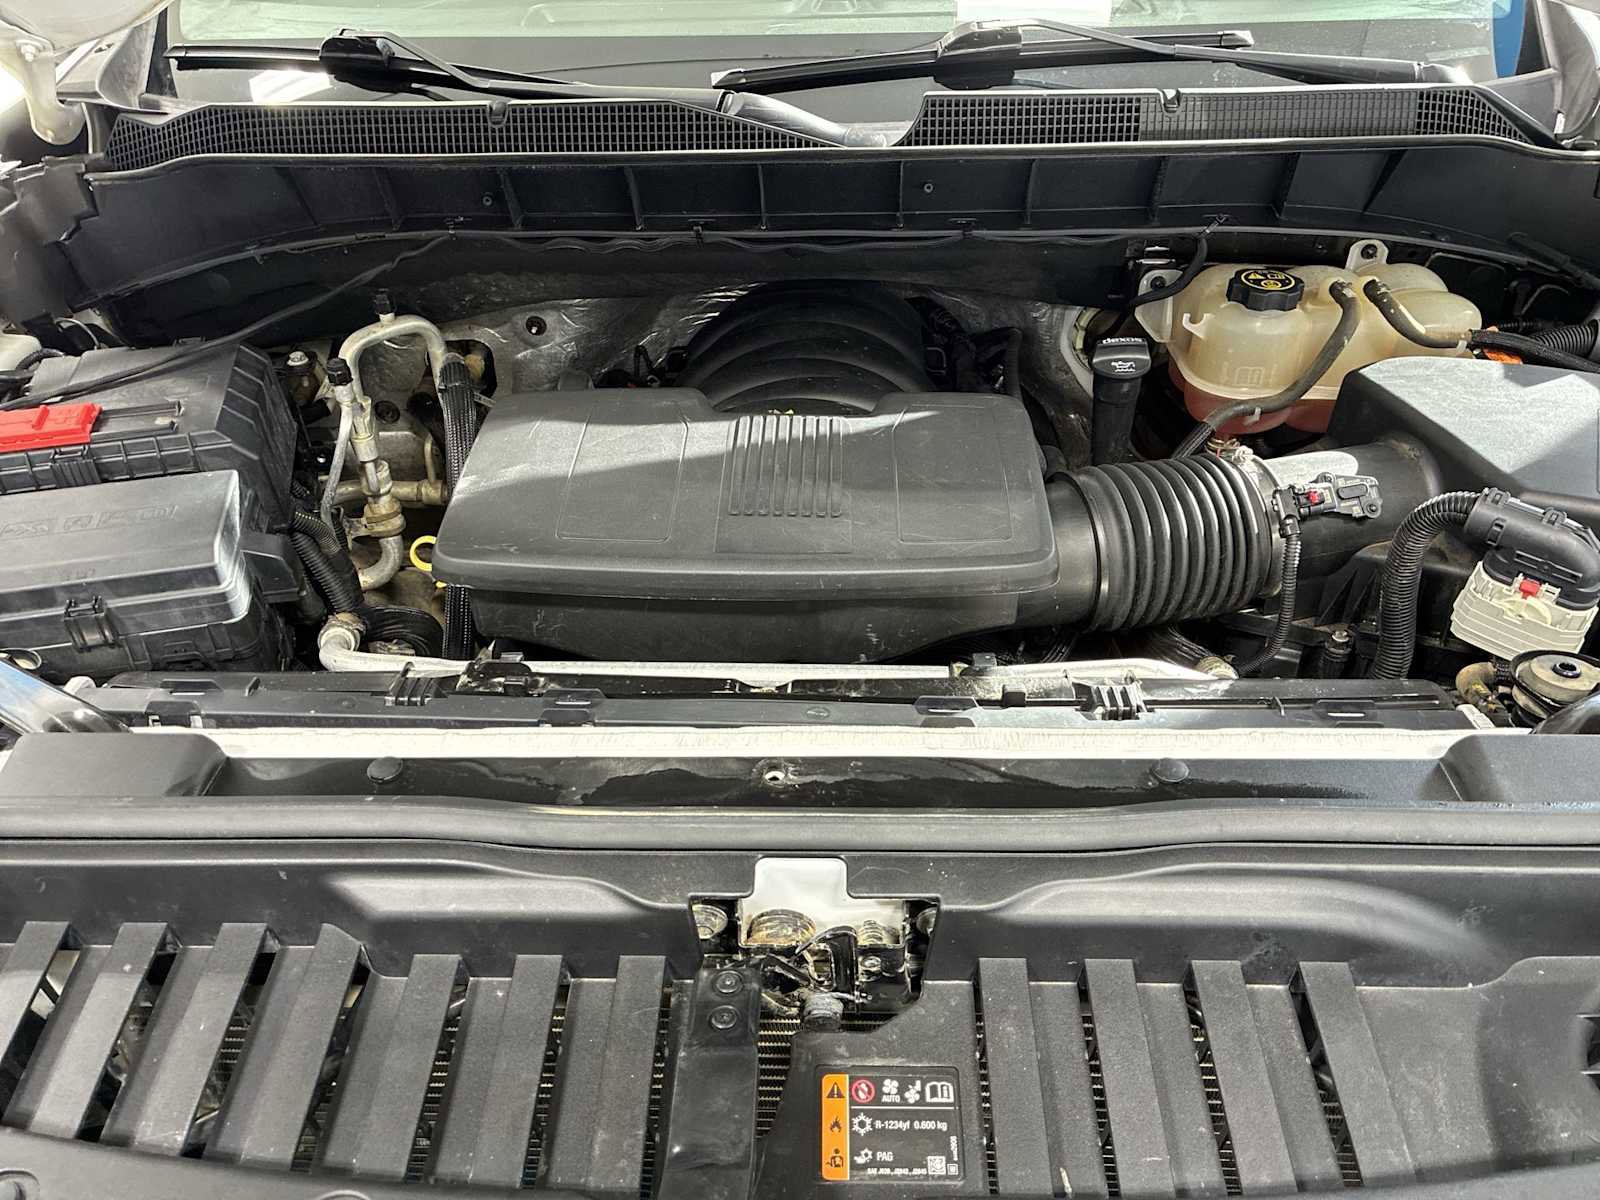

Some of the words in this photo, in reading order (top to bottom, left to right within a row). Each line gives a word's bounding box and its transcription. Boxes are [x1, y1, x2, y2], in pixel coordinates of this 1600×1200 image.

[882, 1095, 901, 1103] AUTO
[875, 1120, 910, 1131] R-1234yf
[913, 1120, 936, 1129] 0.600
[937, 1120, 948, 1131] kg
[876, 1151, 894, 1161] PAG
